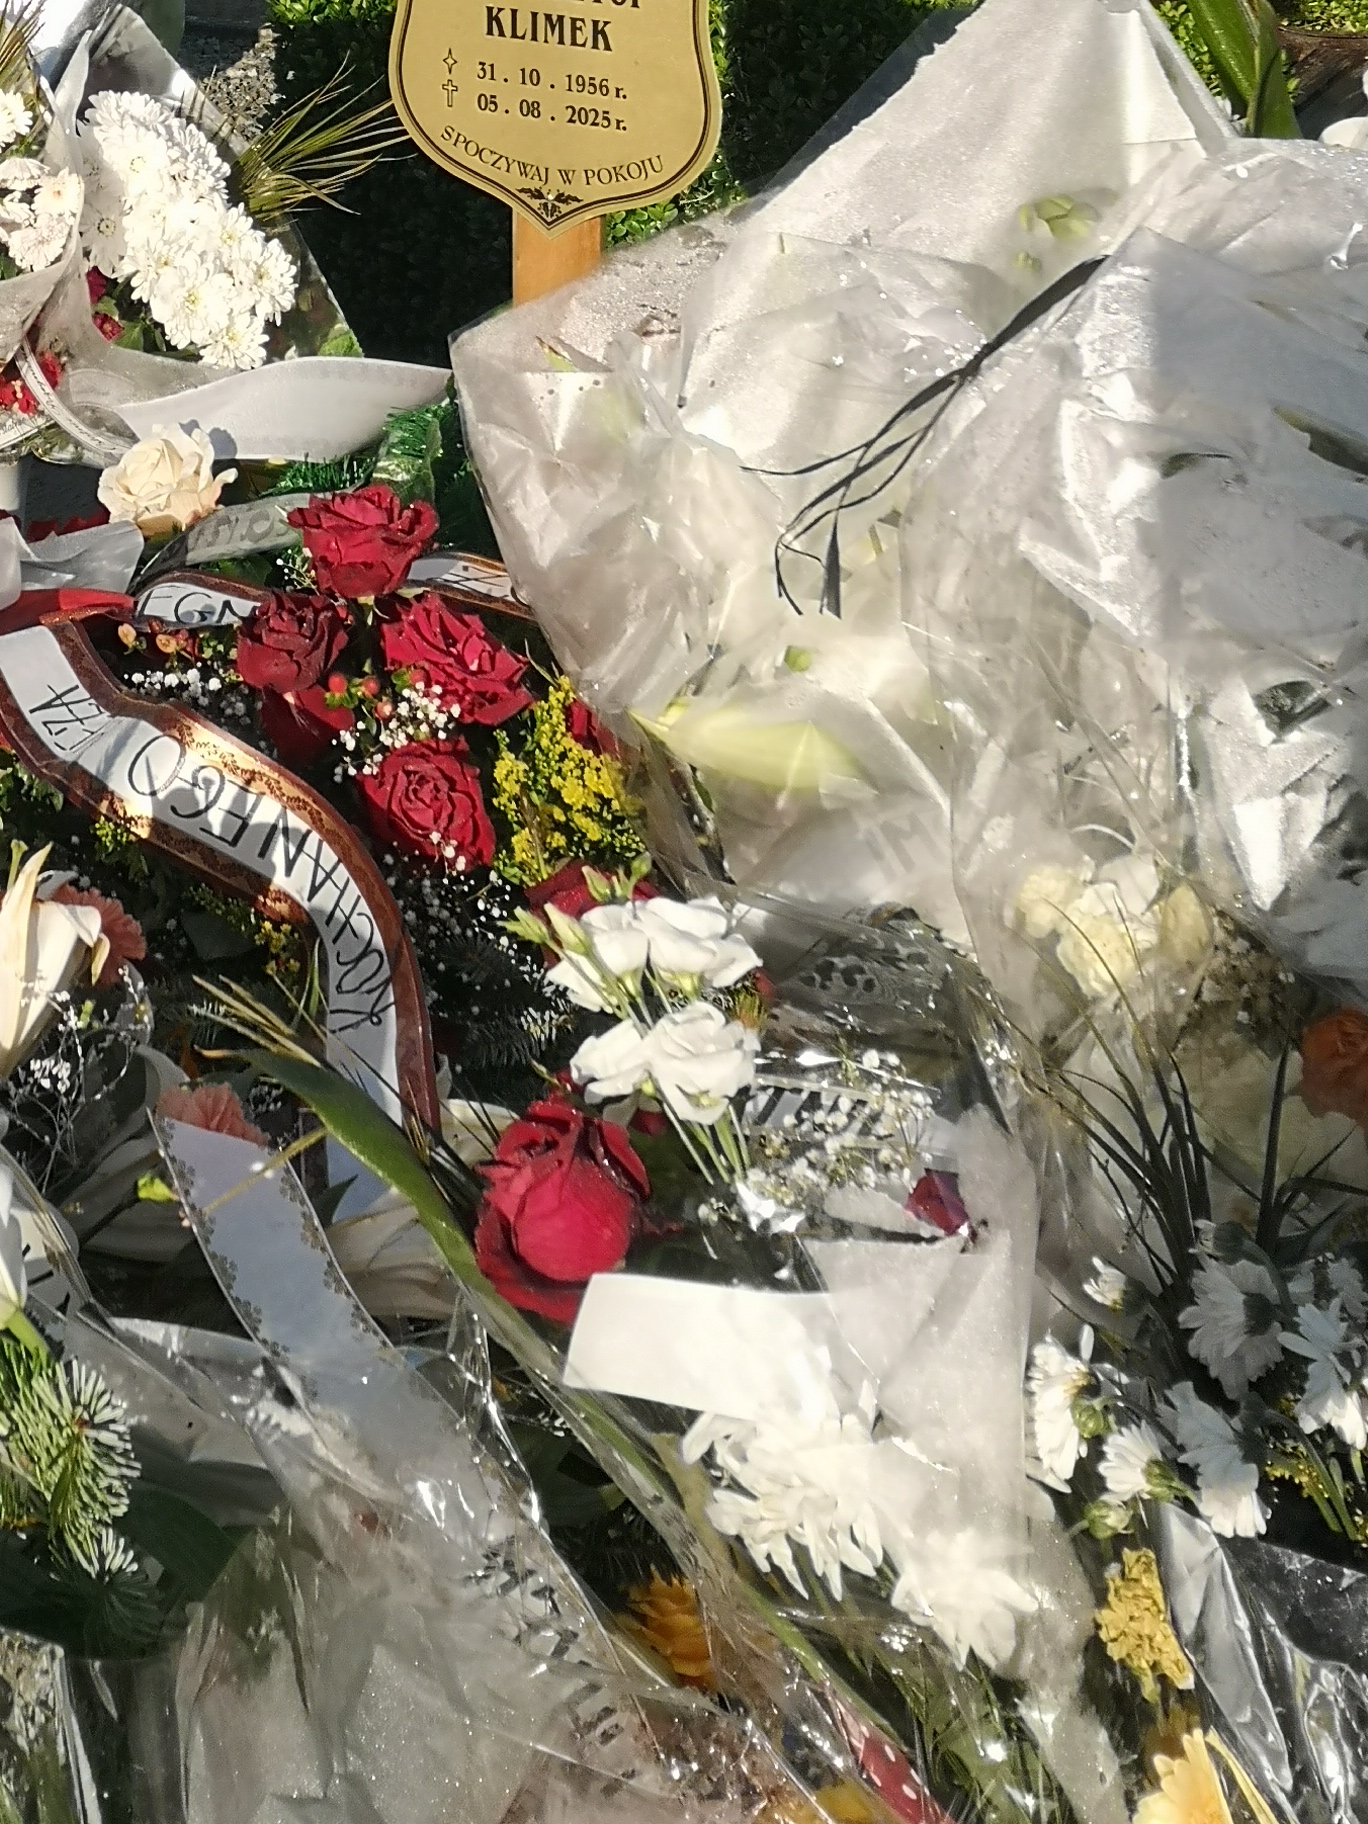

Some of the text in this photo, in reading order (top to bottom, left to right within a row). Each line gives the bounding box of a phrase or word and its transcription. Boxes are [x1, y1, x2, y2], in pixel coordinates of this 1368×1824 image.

[484, 5, 613, 52] KLIMEK
[440, 124, 665, 186] SPOCZYWAJ W POKOJU
[127, 734, 398, 1035] KOCHANEGO
